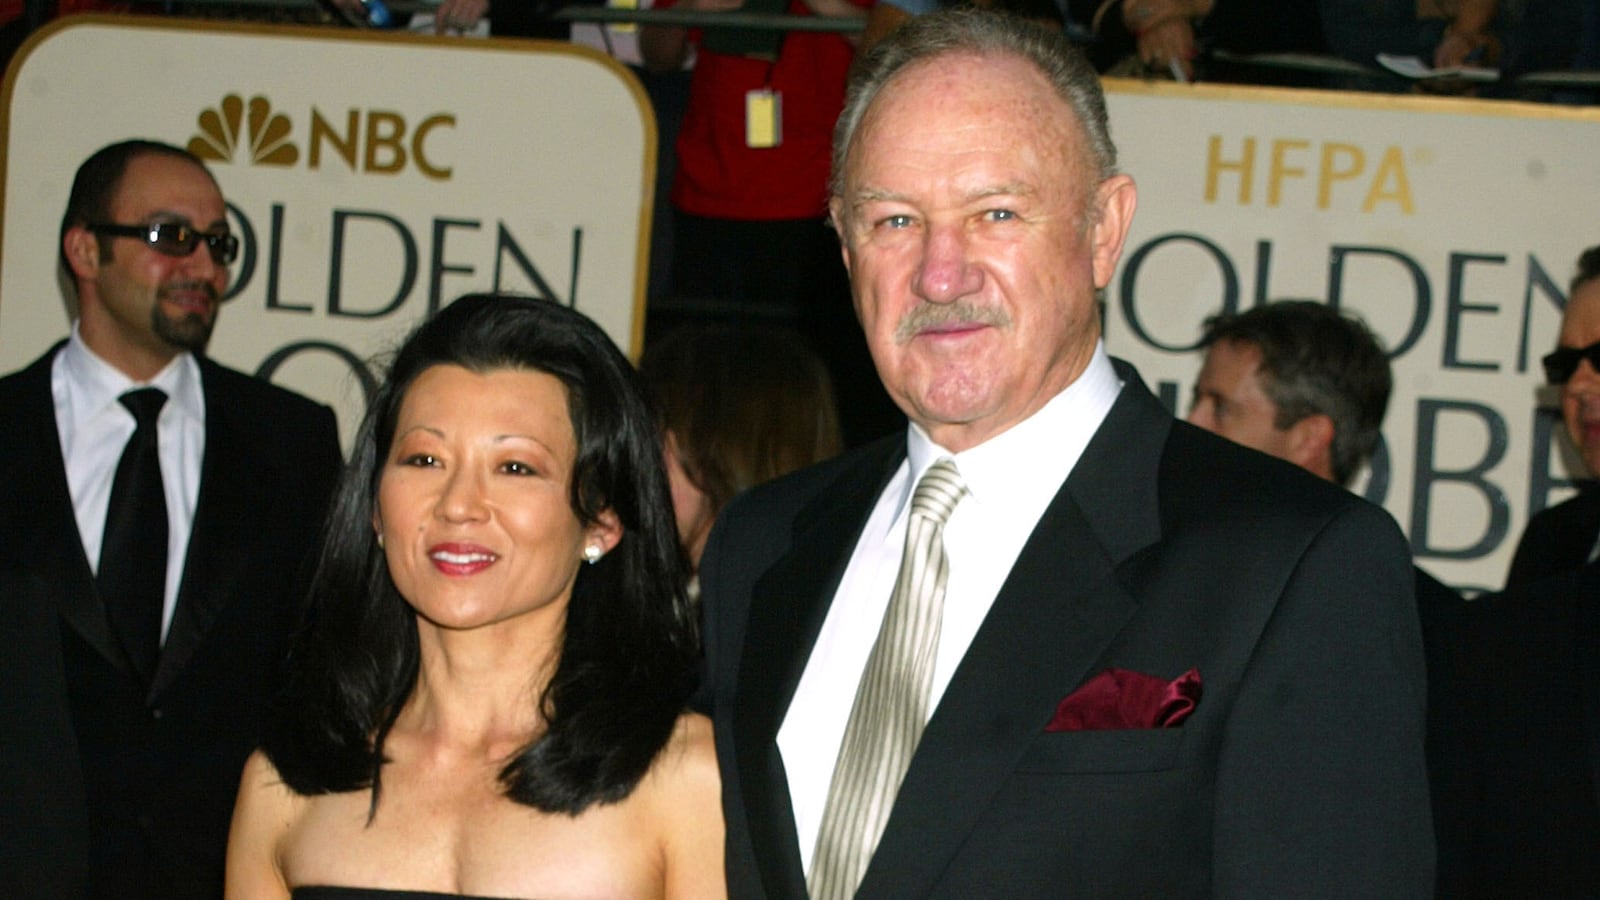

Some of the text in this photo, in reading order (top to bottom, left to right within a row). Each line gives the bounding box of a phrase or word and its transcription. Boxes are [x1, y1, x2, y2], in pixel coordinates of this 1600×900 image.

[308, 104, 456, 181] NBC
[1203, 135, 1416, 215] HFPA
[222, 202, 583, 320] LDEN
[1097, 232, 1569, 373] ODEN
